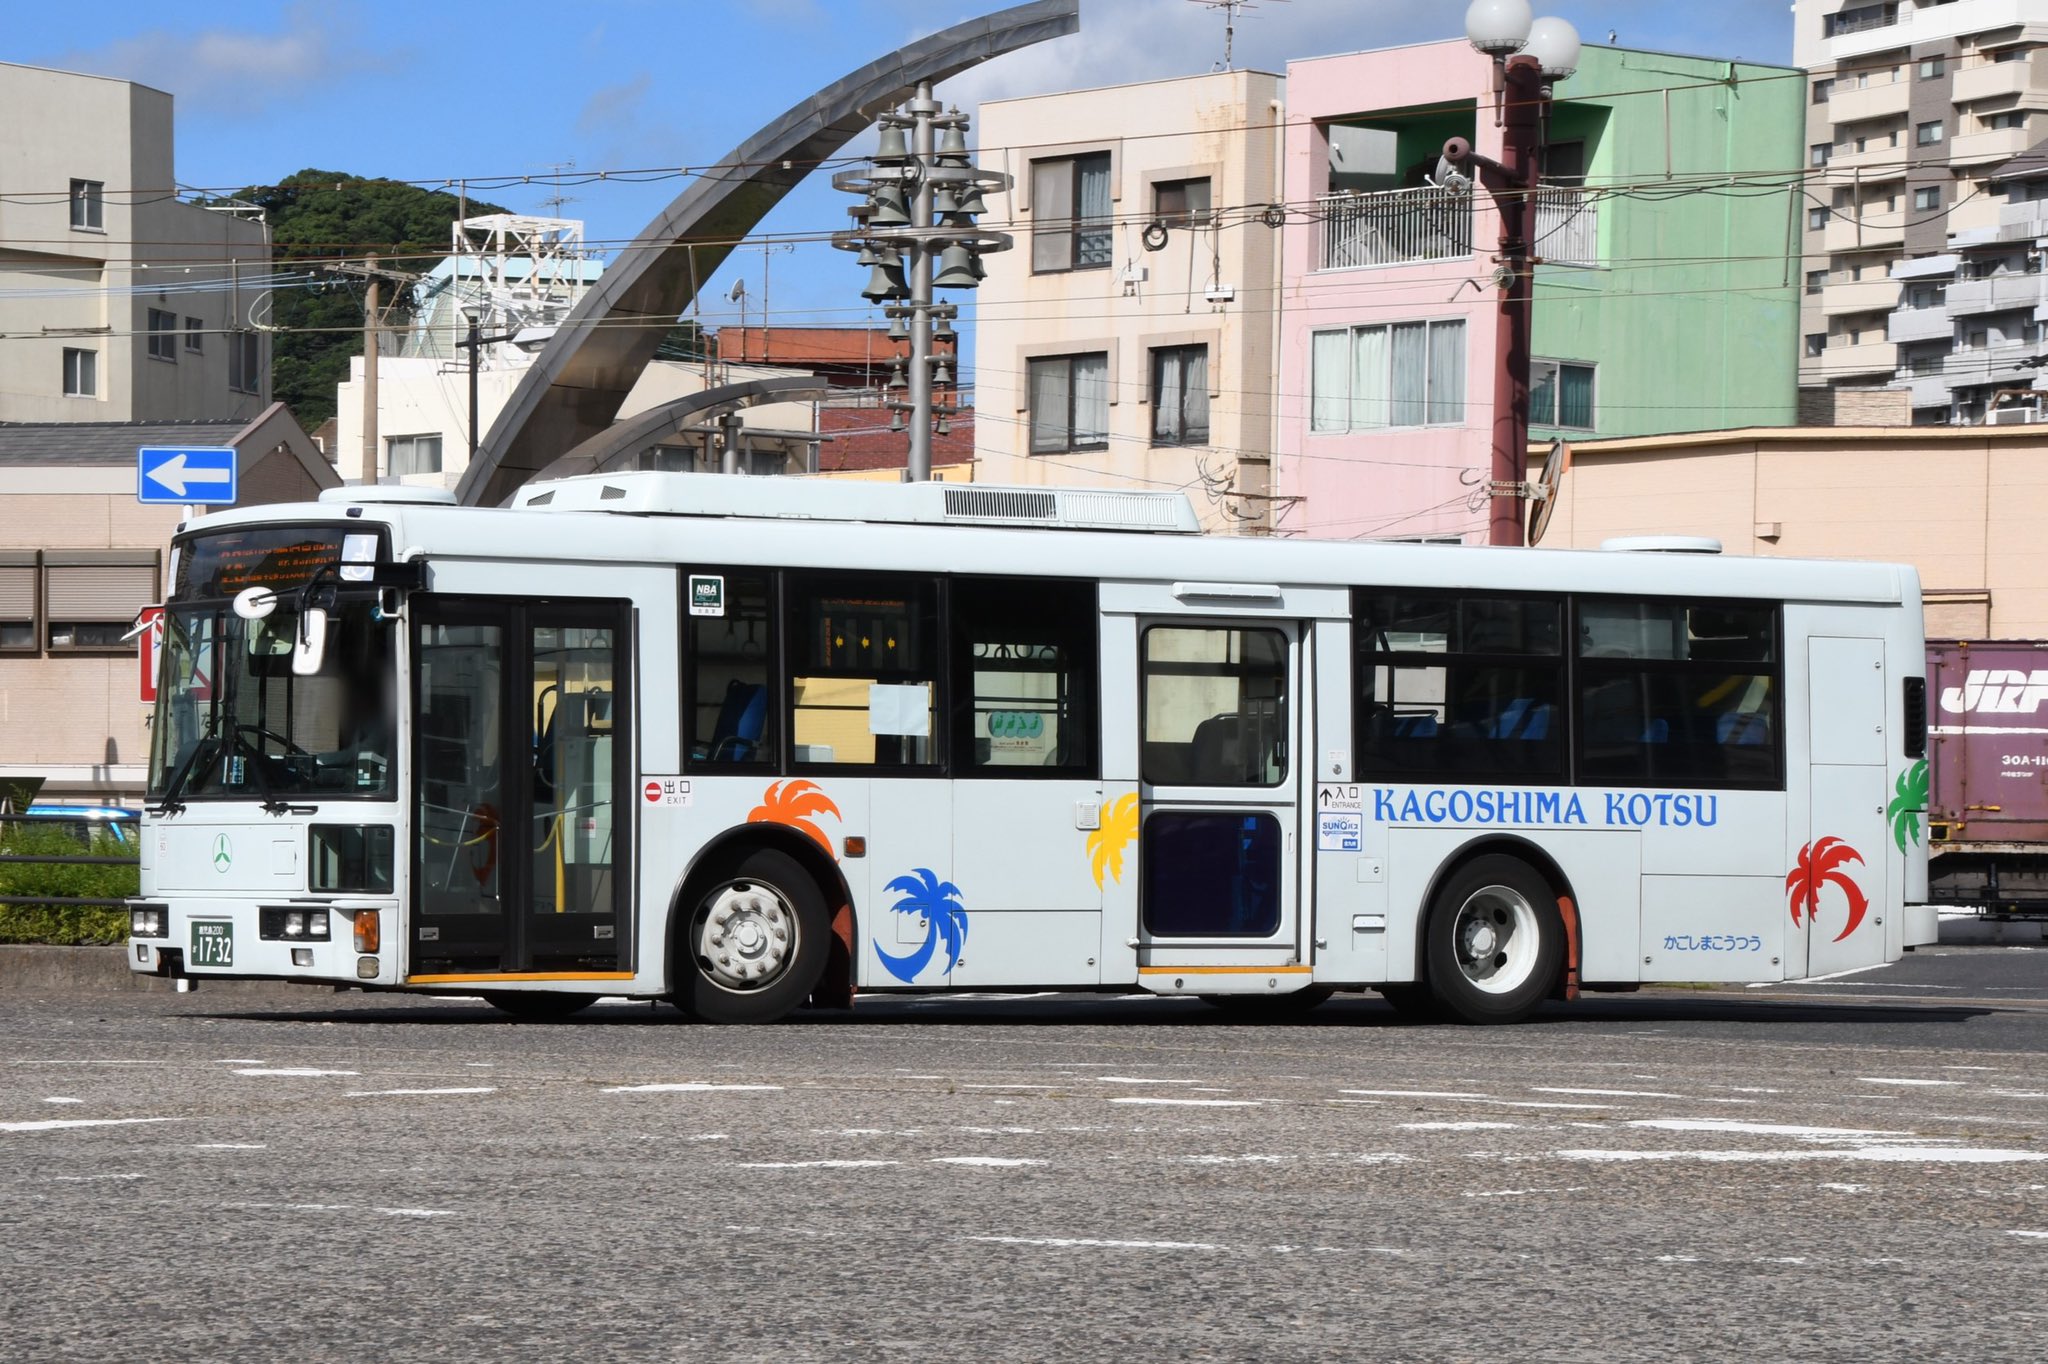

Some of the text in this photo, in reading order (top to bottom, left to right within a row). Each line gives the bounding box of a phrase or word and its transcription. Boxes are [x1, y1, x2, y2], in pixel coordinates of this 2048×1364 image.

[696, 584, 717, 596] NBA
[2001, 755, 2048, 766] 30A-11
[664, 780, 690, 794] 出口
[1336, 787, 1358, 799] 入口
[1374, 788, 1718, 828] KAGOSHIMA KOTSU
[200, 936, 231, 962] 17-32
[1664, 935, 1761, 951] かごしまこうつう
